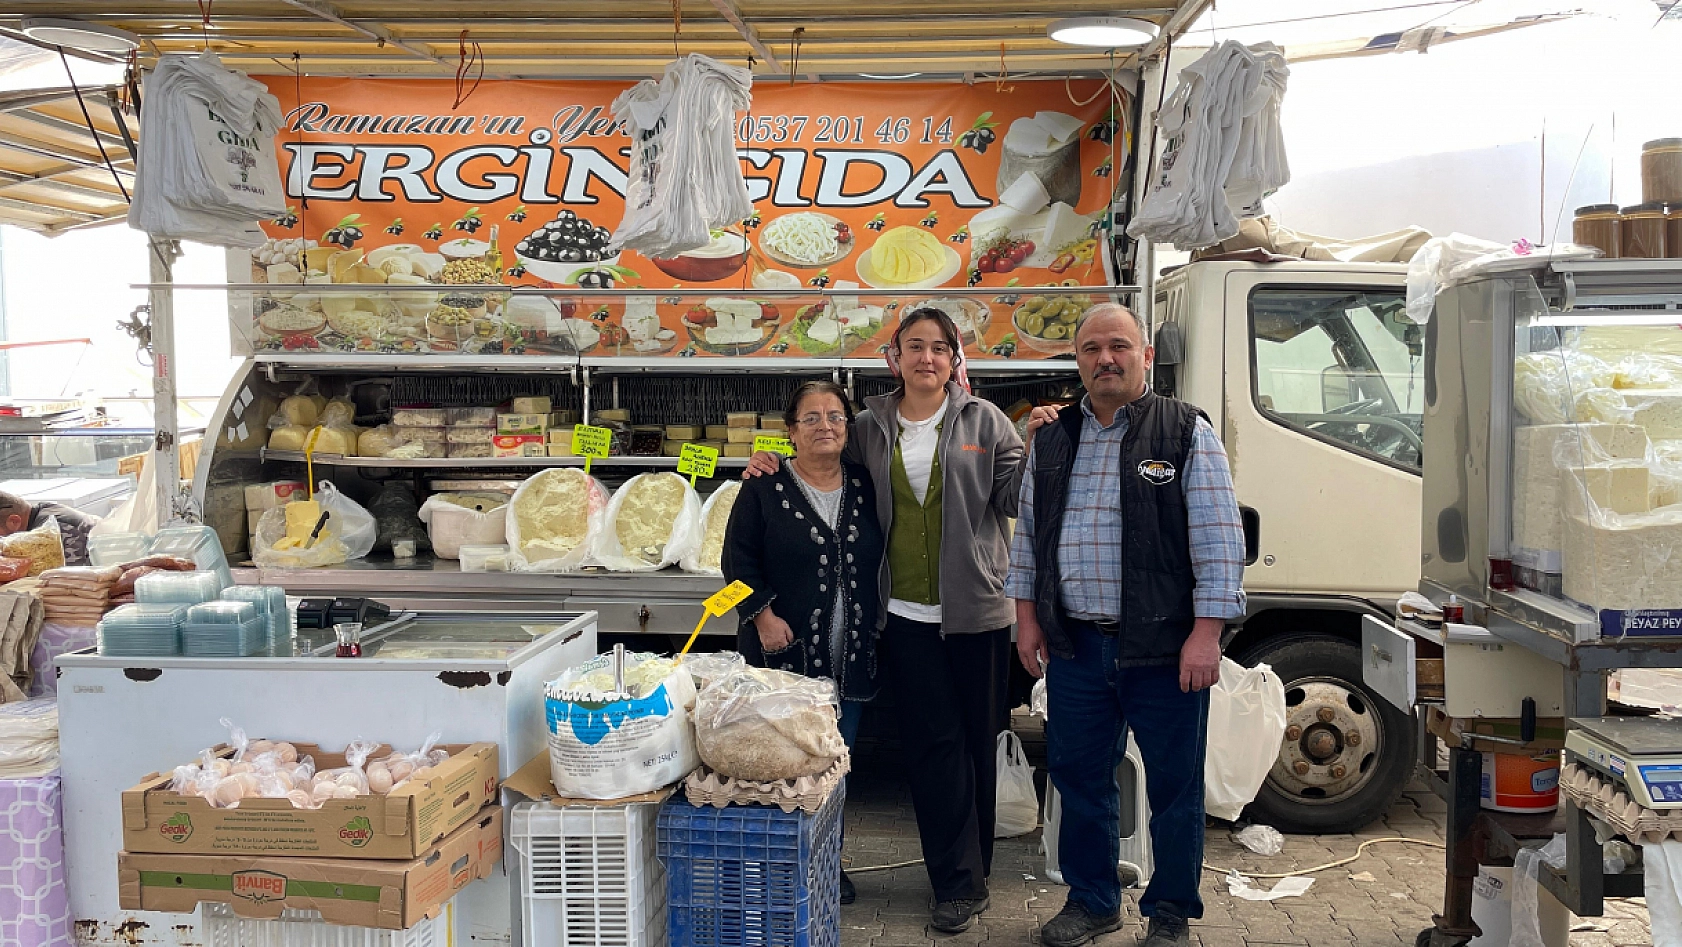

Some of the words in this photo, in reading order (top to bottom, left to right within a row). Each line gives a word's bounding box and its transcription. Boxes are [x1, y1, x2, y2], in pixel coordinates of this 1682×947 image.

[284, 102, 526, 136] Ramazan'ın
[738, 114, 810, 143] 0537
[813, 115, 865, 144] 201
[874, 115, 911, 144] 46
[919, 116, 954, 144] 14
[160, 823, 188, 835] Gedik
[339, 827, 369, 839] Gedik
[236, 875, 283, 894] Banvit
